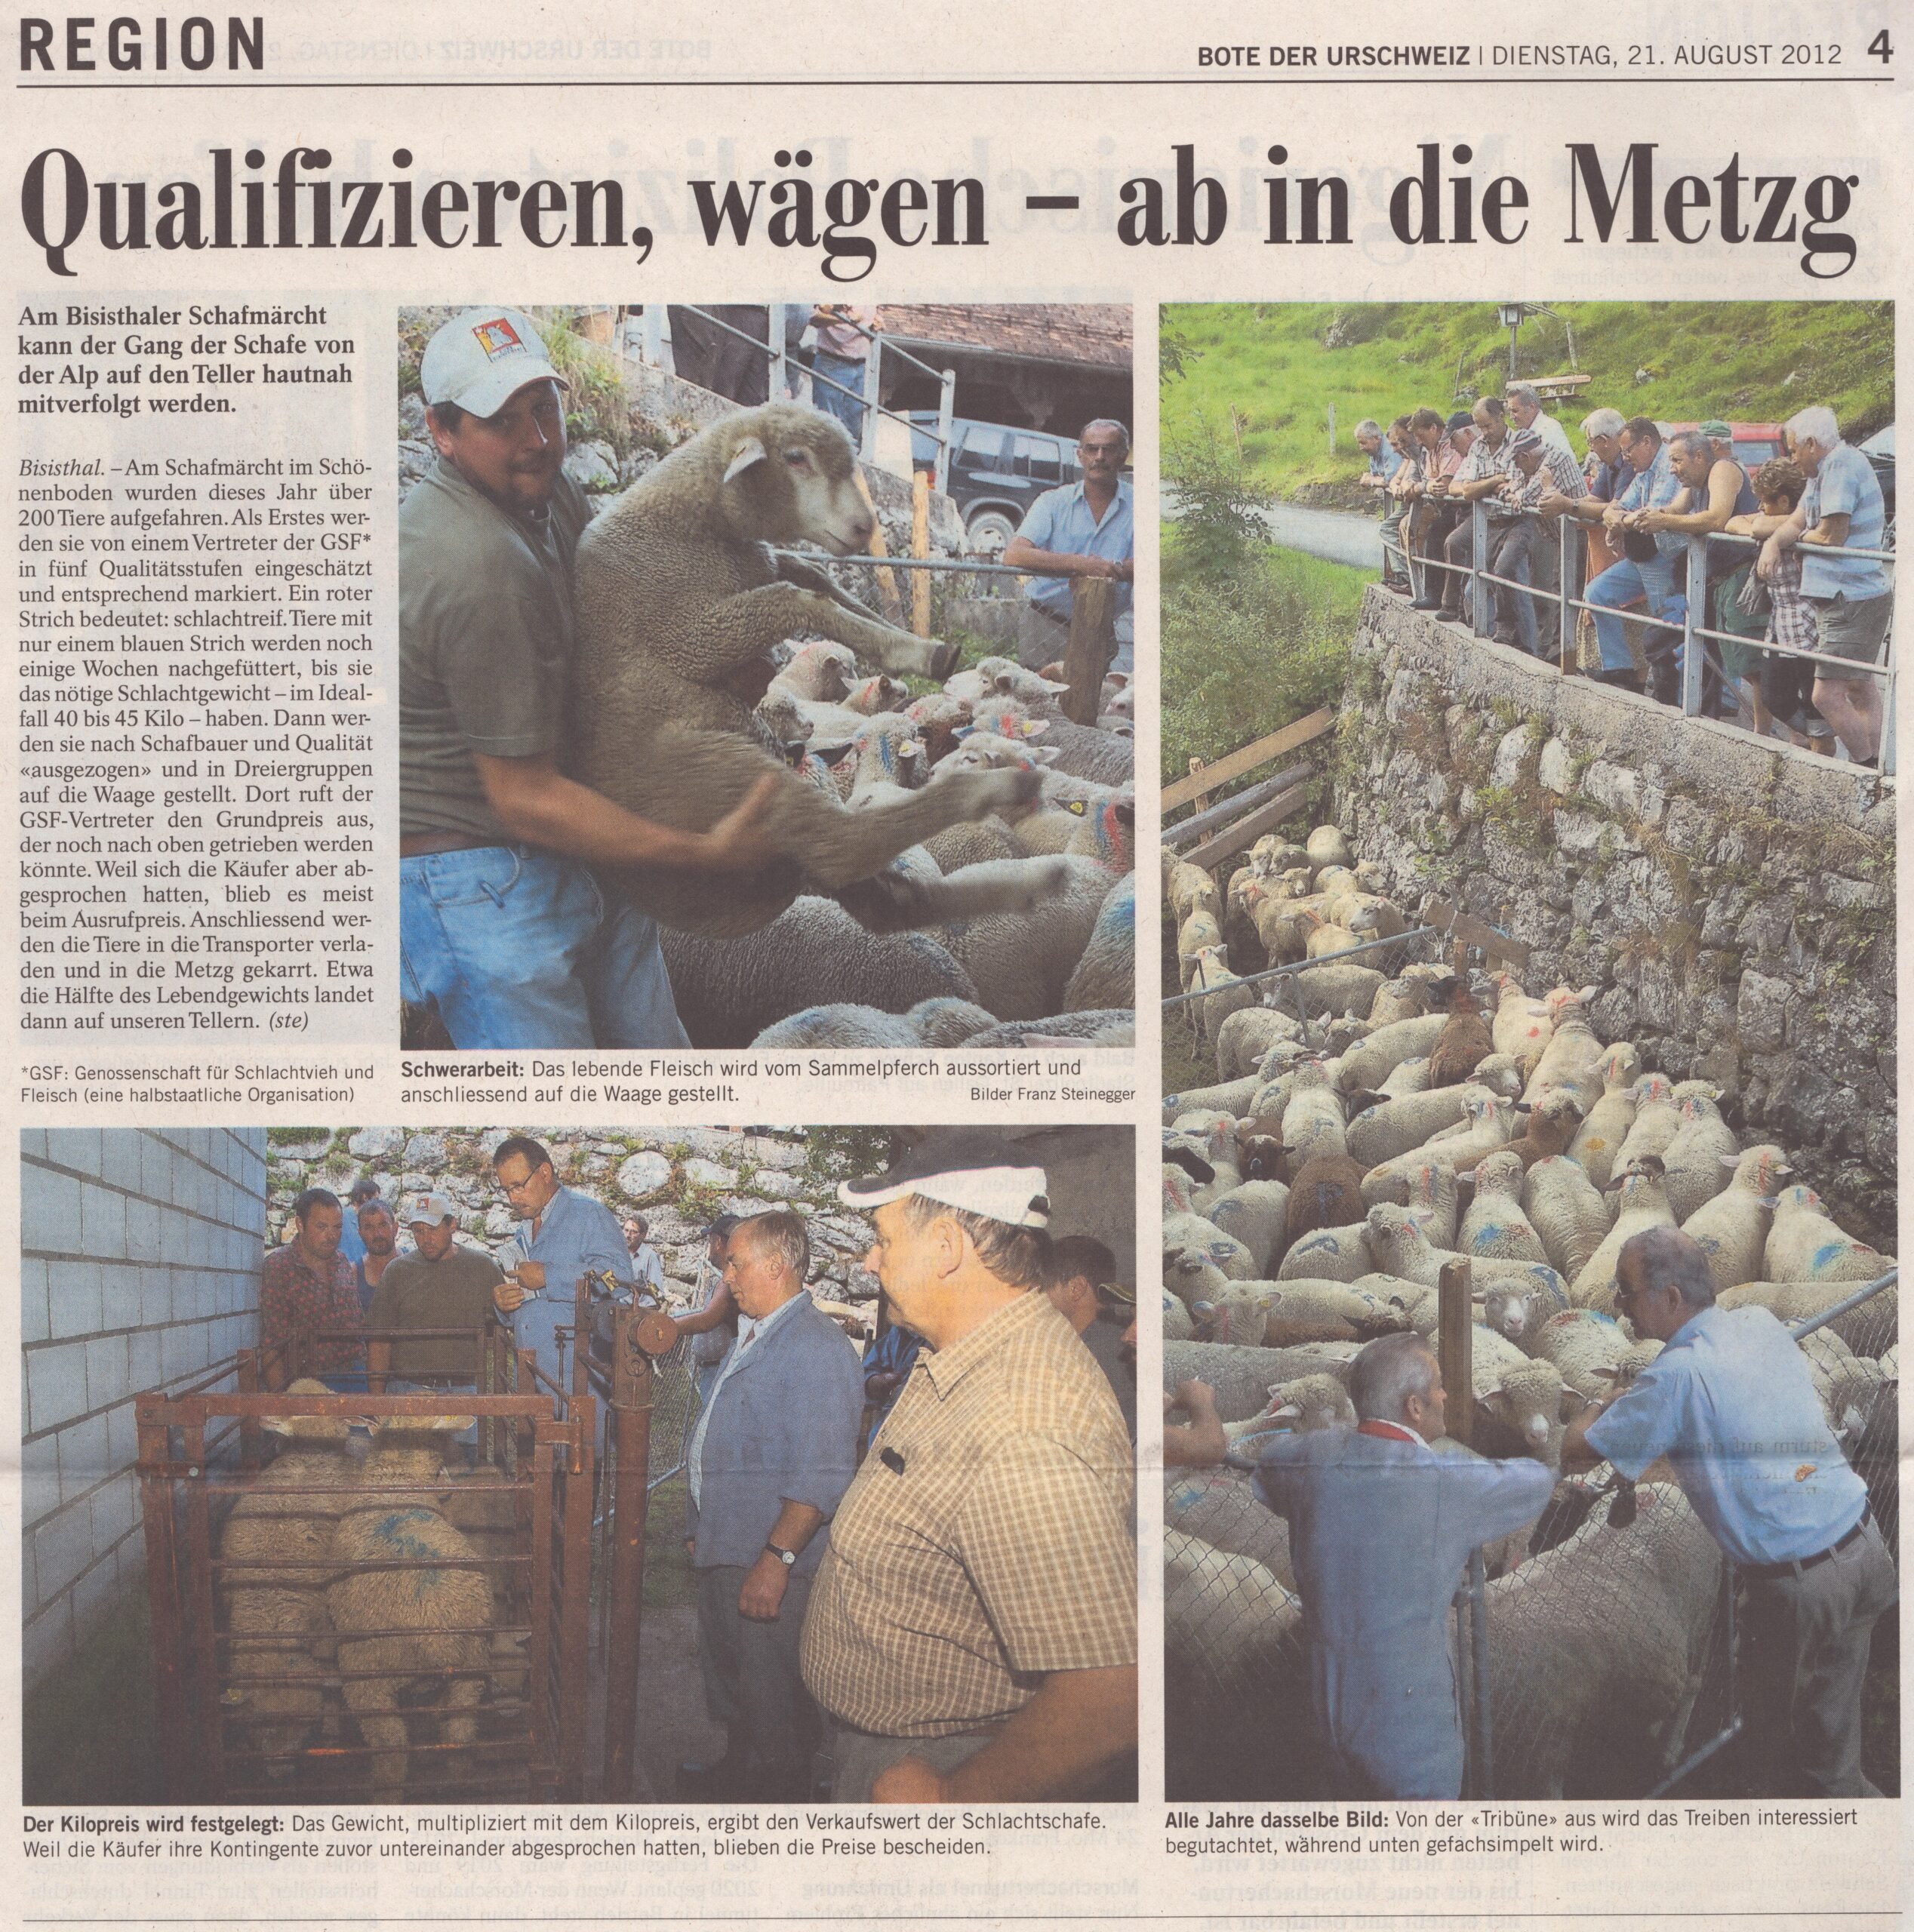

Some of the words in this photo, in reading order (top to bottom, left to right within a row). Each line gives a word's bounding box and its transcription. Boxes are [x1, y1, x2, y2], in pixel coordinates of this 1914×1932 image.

[20, 17, 263, 71] REGION
[1867, 29, 1894, 64] 4
[1199, 46, 1260, 66] BOTE
[1269, 46, 1317, 66] DER
[1327, 45, 1470, 66] URSCHWEIZ
[1493, 45, 1617, 69] DIENSTAG,
[1628, 45, 1664, 65] 21.
[1674, 45, 1773, 65] AUGUST
[1781, 44, 1842, 65] 2012
[21, 147, 654, 277] Qualifizieren,
[687, 149, 989, 283] wägen
[1117, 143, 1228, 247] ab
[1263, 144, 1353, 245] in
[1389, 143, 1529, 245] die
[1564, 143, 1860, 279] Metzg
[17, 306, 59, 326] Am
[66, 305, 182, 326] Bisisthaler
[189, 304, 327, 325] Schafmärcht
[17, 334, 73, 355] kann
[80, 334, 117, 355] der
[124, 334, 183, 361] Gang
[190, 334, 227, 355] der
[234, 334, 307, 355] Schafe
[314, 340, 355, 354] von
[18, 365, 55, 385] der
[58, 364, 99, 389] Alp
[106, 364, 142, 384] auf
[149, 364, 189, 384] den
[192, 363, 256, 384] Teller
[262, 362, 352, 383] hautnah
[17, 392, 141, 419] mitverfolgt
[147, 392, 236, 413] werden.
[19, 458, 106, 477] Bisisthal.
[126, 459, 160, 477] Am
[165, 457, 285, 477] Schafmärcht
[289, 458, 314, 476] im
[319, 457, 373, 476] Schö-
[18, 509, 55, 527] 200
[57, 509, 105, 526] Tiere
[110, 508, 229, 531] aufgefahren.
[231, 508, 263, 526] Als
[268, 508, 325, 525] Erstes
[330, 512, 371, 525] wer-
[18, 585, 55, 602] und
[61, 584, 189, 607] entsprechend
[194, 584, 282, 602] markiert.
[288, 584, 320, 601] Ein
[326, 586, 373, 601] roter
[19, 660, 75, 682] einige
[82, 659, 158, 677] Wochen
[168, 659, 302, 681] nachgefüttert,
[311, 659, 338, 676] bis
[348, 659, 373, 676] sie
[19, 734, 54, 752] den
[60, 735, 85, 752] sie
[91, 734, 136, 752] nach
[141, 734, 248, 752] Schafbauer
[253, 734, 290, 752] und
[295, 734, 374, 754] Qualität
[20, 811, 155, 829] GSF-Vertreter
[168, 810, 203, 828] den
[216, 810, 323, 832] Grundpreis
[337, 814, 374, 831] aus,
[20, 884, 128, 908] gesprochen
[143, 884, 209, 906] hatten,
[224, 884, 271, 903] blieb
[287, 890, 306, 903] es
[322, 884, 374, 902] meist
[20, 1011, 68, 1029] dann
[74, 1011, 105, 1029] auf
[110, 1017, 186, 1029] unseren
[188, 1011, 260, 1029] Tellern.
[269, 1011, 309, 1032] (ste)
[75, 1065, 201, 1081] Genossenschaft
[206, 1065, 229, 1080] für
[235, 1065, 337, 1080] Schlachtvieh
[345, 1064, 374, 1079] und
[401, 1060, 524, 1078] Schwerarbeit:
[533, 1060, 565, 1077] Das
[572, 1060, 642, 1077] lebende
[651, 1060, 712, 1077] Fleisch
[720, 1060, 758, 1076] wird
[765, 1063, 801, 1076] vom
[808, 1059, 939, 1080] Sammelpferch
[946, 1059, 1041, 1075] aussortiert
[1048, 1059, 1081, 1075] und
[21, 1088, 77, 1103] Fleisch
[84, 1088, 123, 1104] (eine
[130, 1087, 242, 1103] halbstaatliche
[248, 1086, 354, 1106] Organisation)
[401, 1085, 527, 1103] anschliessend
[534, 1085, 563, 1102] auf
[570, 1085, 597, 1102] die
[604, 1085, 662, 1106] Waage
[668, 1084, 739, 1106] gestellt.
[971, 1087, 1013, 1100] Bilder
[1018, 1087, 1056, 1100] Franz
[1061, 1087, 1136, 1103] Steinegger
[23, 1816, 54, 1832] Der
[61, 1815, 140, 1836] Kilopreis
[146, 1815, 184, 1832] wird
[190, 1815, 284, 1836] festgelegt:
[293, 1814, 325, 1832] Das
[331, 1814, 409, 1834] Gewicht,
[417, 1814, 527, 1835] multipliziert
[534, 1814, 563, 1831] mit
[570, 1814, 608, 1831] dem
[617, 1813, 700, 1834] Kilopreis,
[708, 1813, 759, 1834] ergibt
[766, 1813, 799, 1830] den
[806, 1812, 921, 1830] Verkaufswert
[928, 1812, 955, 1829] der
[962, 1811, 1106, 1829] Schlachtschafe.
[1165, 1811, 1199, 1829] Alle
[1205, 1811, 1254, 1829] Jahre
[1260, 1810, 1340, 1828] dasselbe
[1346, 1810, 1389, 1828] Bild:
[1395, 1810, 1427, 1828] Von
[1435, 1810, 1463, 1827] der
[1472, 1810, 1557, 1827] «Tribüne»
[1565, 1814, 1596, 1827] aus
[1602, 1809, 1639, 1826] wird
[1648, 1809, 1678, 1826] das
[1684, 1809, 1749, 1826] Treiben
[1759, 1807, 1857, 1826] interessiert
[23, 1841, 60, 1858] Weil
[68, 1841, 95, 1858] die
[103, 1840, 162, 1857] Käufer
[170, 1840, 202, 1857] ihre
[211, 1840, 318, 1861] Kontingente
[325, 1844, 373, 1857] zuvor
[380, 1839, 505, 1857] untereinander
[512, 1839, 635, 1860] abgesprochen
[644, 1839, 706, 1858] hatten,
[714, 1838, 780, 1856] blieben
[787, 1838, 814, 1855] die
[822, 1838, 875, 1855] Preise
[884, 1838, 990, 1855] bescheiden.
[1166, 1837, 1278, 1857] begutachtet,
[1285, 1835, 1361, 1853] während
[1369, 1836, 1419, 1853] unten
[1426, 1835, 1554, 1857] gefachsimpelt
[1560, 1835, 1603, 1851] wird.
